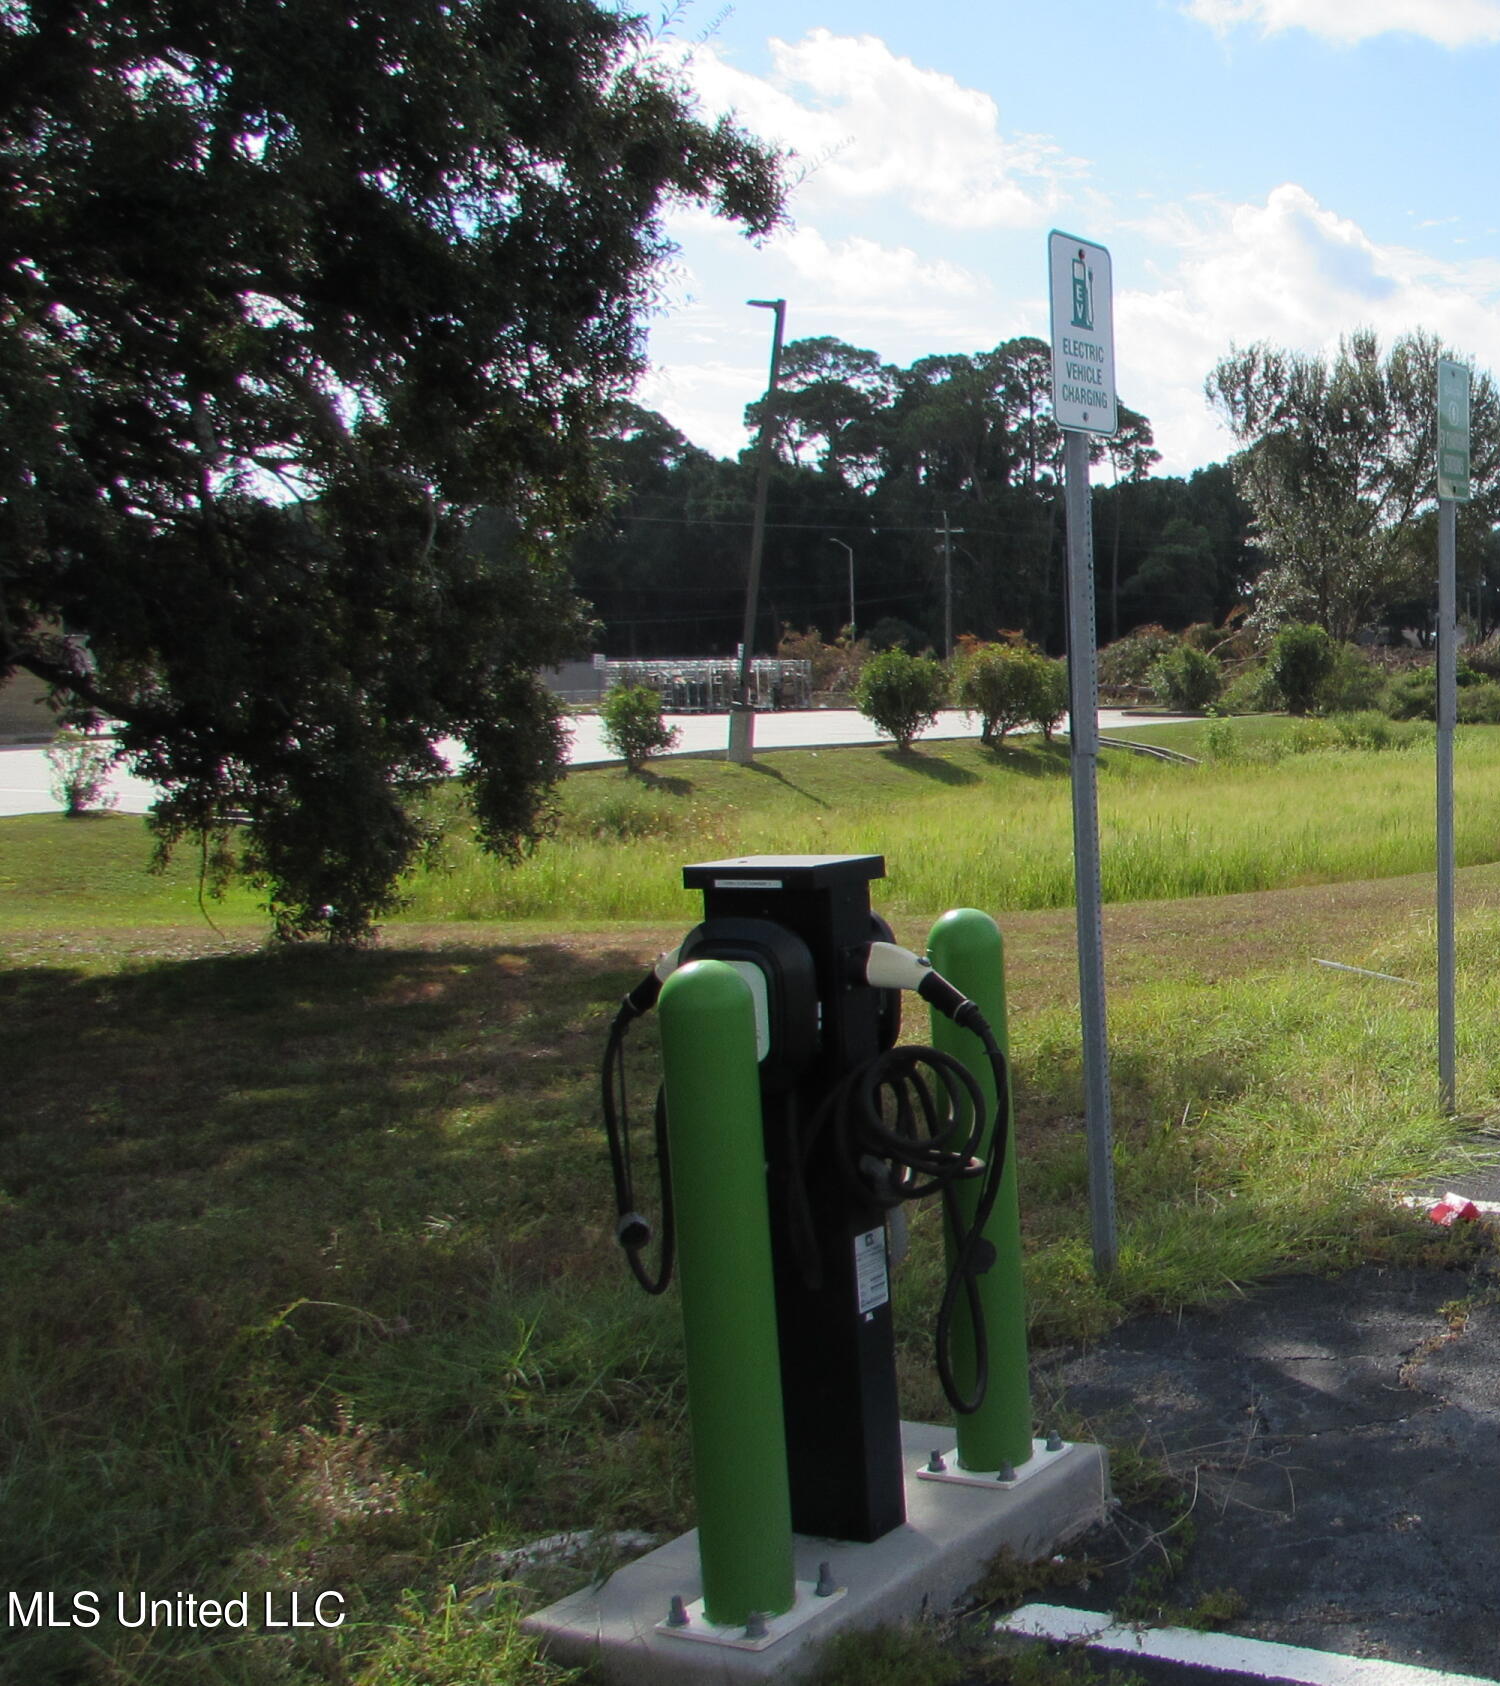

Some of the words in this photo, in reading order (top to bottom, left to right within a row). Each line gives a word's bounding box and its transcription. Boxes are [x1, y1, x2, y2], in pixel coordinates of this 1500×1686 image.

[1063, 338, 1104, 362] ELECTRIC
[1067, 362, 1102, 385] VEHICLE
[1063, 385, 1107, 408] CHARGING
